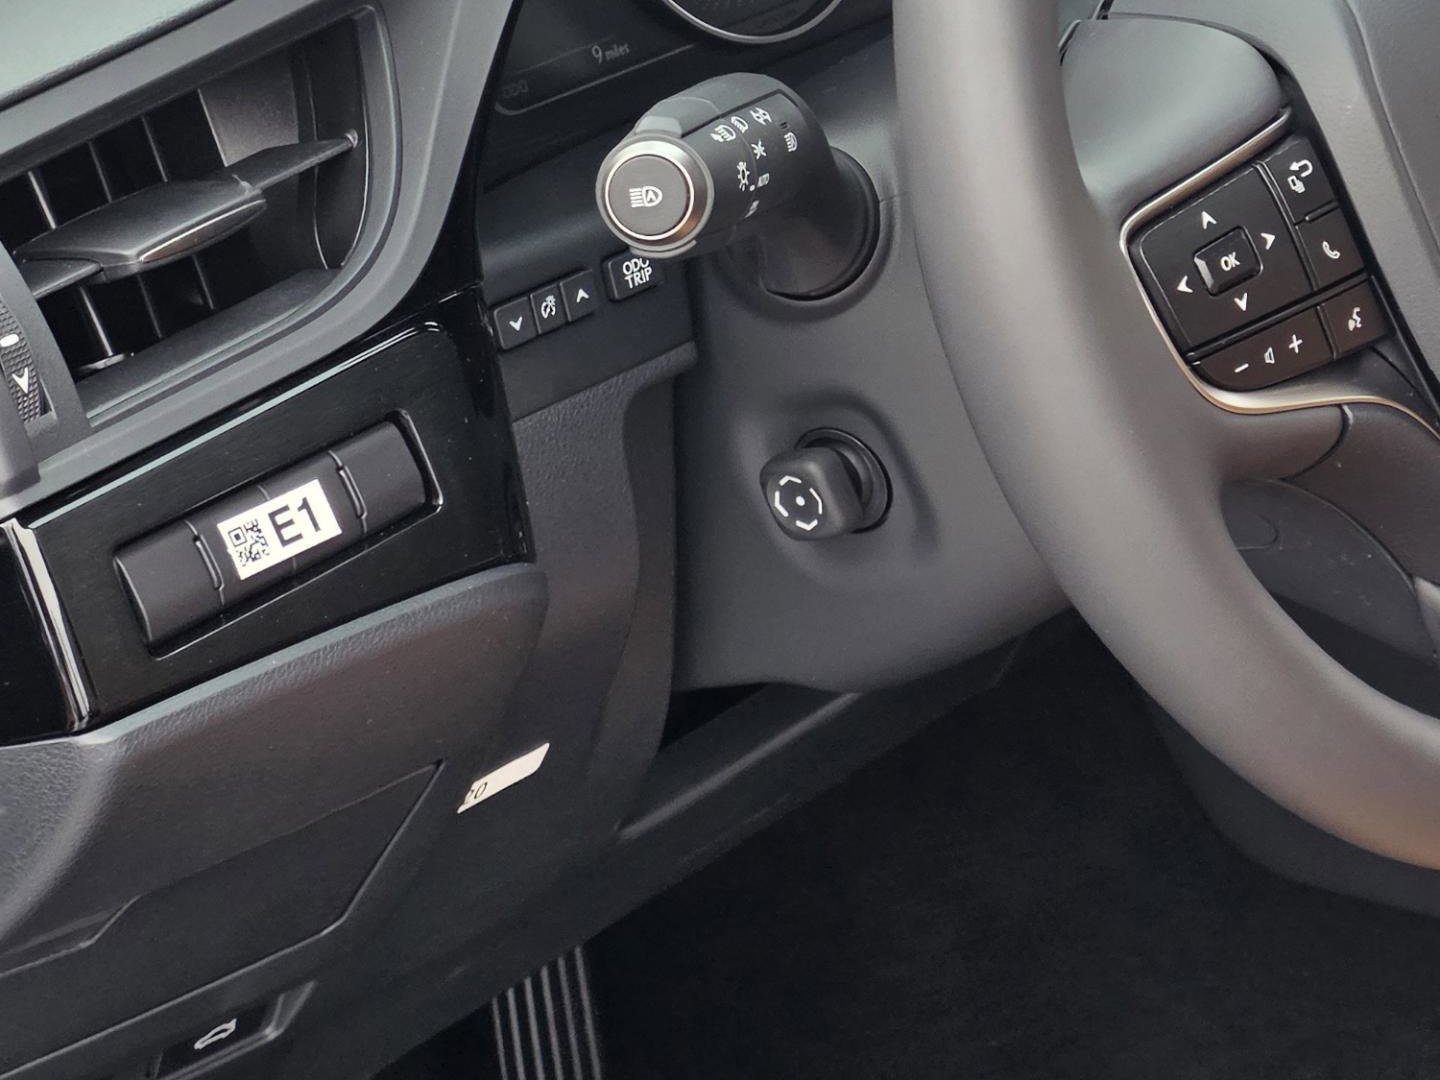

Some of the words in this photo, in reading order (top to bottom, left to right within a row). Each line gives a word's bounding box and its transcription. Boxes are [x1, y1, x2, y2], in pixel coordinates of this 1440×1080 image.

[591, 44, 604, 64] 9
[605, 42, 631, 62] miles
[1219, 251, 1241, 272] OK
[624, 265, 653, 289] TRIP
[267, 496, 322, 548] E1
